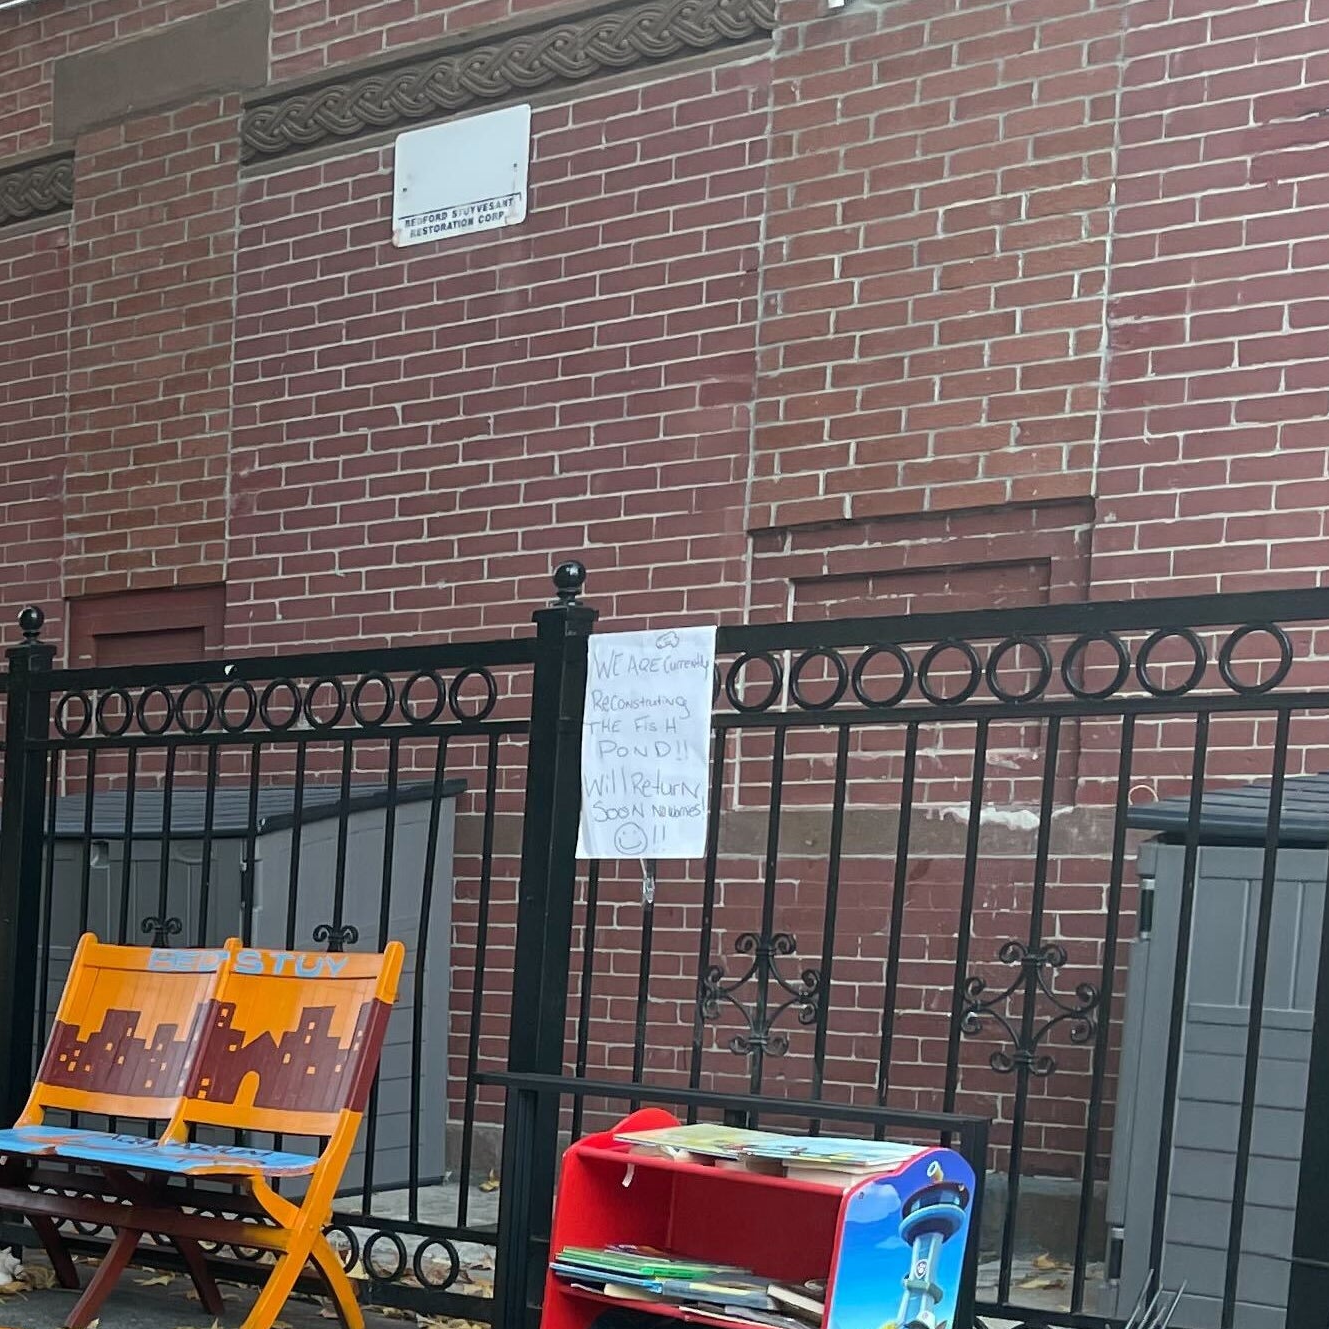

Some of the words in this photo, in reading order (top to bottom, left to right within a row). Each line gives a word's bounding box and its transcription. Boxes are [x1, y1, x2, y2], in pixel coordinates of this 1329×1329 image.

[405, 211, 448, 228] BEDFORD
[451, 197, 514, 218] STUYVESANT
[409, 218, 475, 238] RESTORATION
[594, 650, 624, 679] WE
[628, 655, 663, 676] ARE
[583, 718, 622, 735] THE
